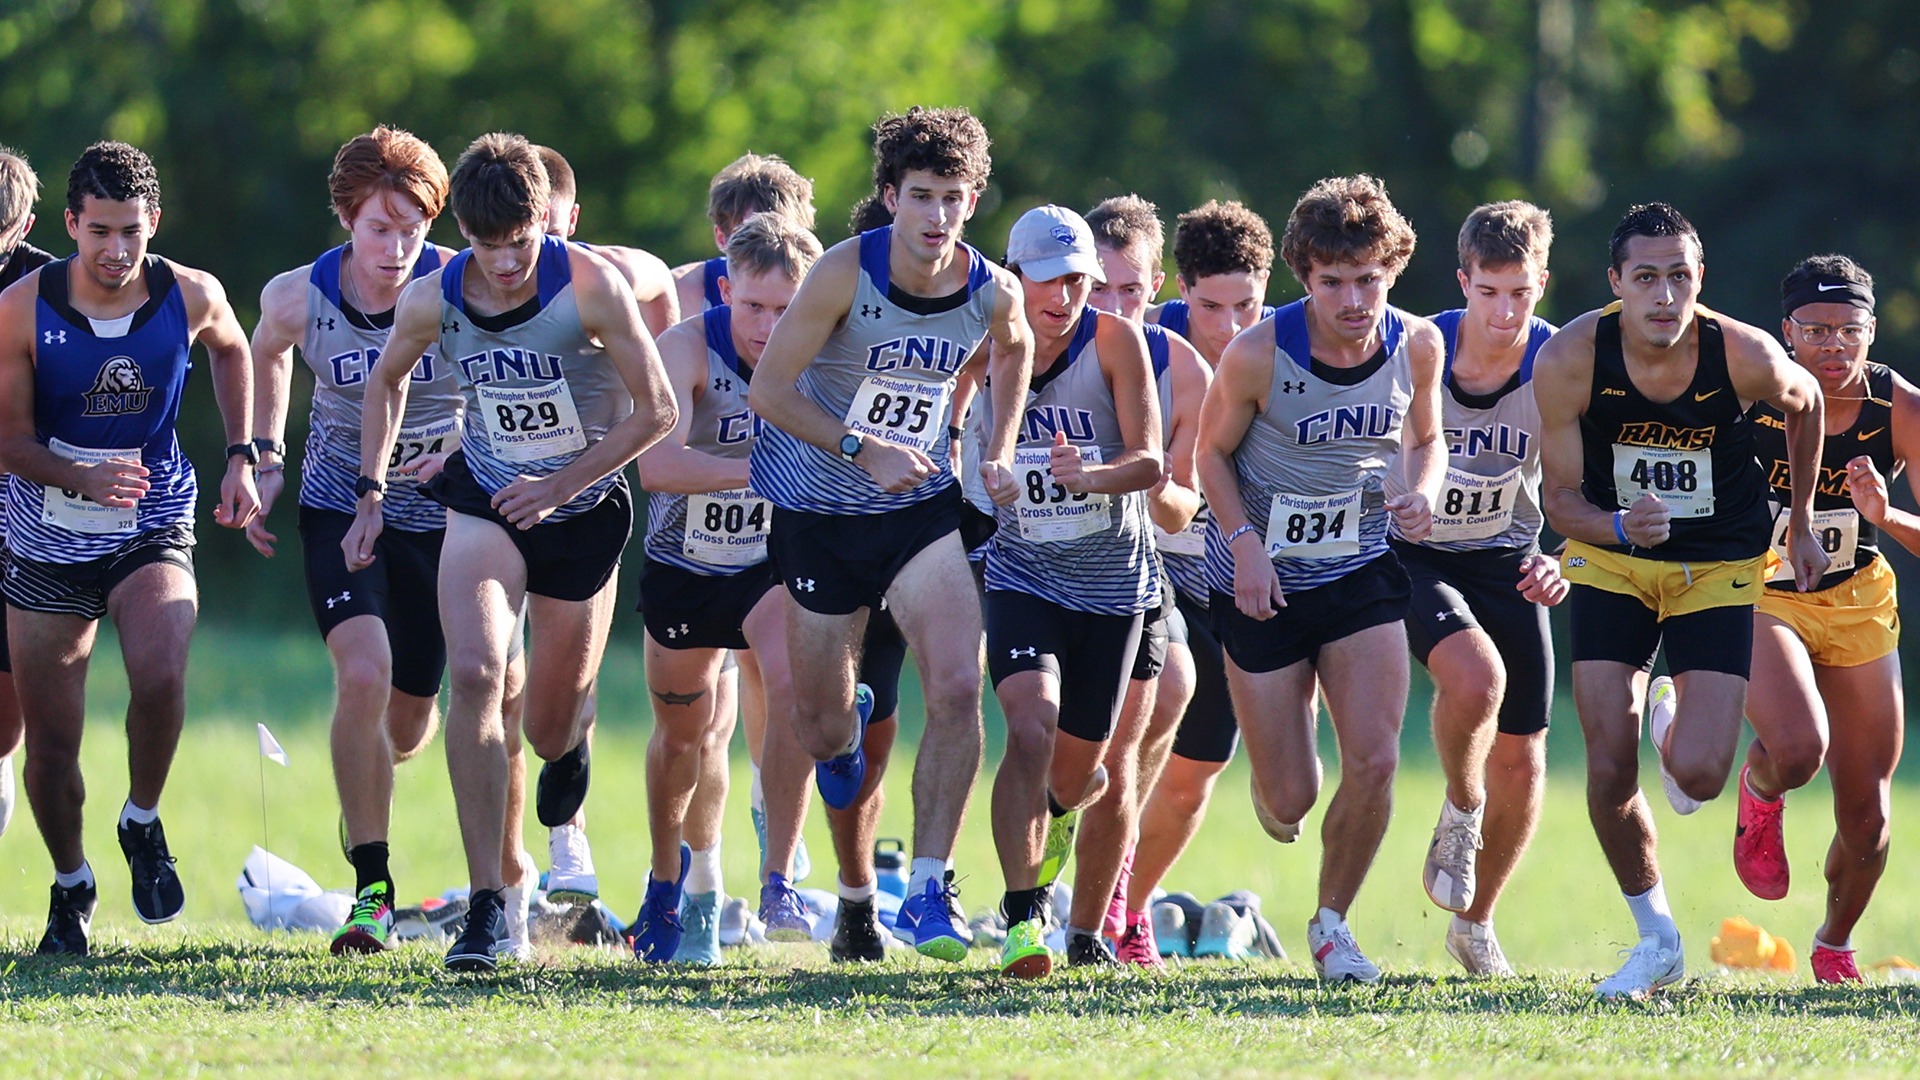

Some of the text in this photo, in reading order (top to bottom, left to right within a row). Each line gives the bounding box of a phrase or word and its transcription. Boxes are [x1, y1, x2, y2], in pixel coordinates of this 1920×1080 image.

[459, 347, 563, 386] CNU
[866, 336, 969, 374] CNU
[481, 384, 562, 402] Christopher Newport
[870, 376, 915, 394] Christopher
[88, 391, 147, 413] EMU
[496, 401, 559, 432] 829
[867, 393, 933, 434] 835
[425, 421, 456, 437] Newport
[493, 425, 574, 443] Cross Country
[850, 420, 931, 451] Cross Country
[1018, 404, 1093, 444] NU
[1295, 402, 1394, 445] CNU
[1617, 421, 1716, 451] RAMS
[1015, 452, 1051, 466] Christoph
[1026, 467, 1089, 504] 83
[1486, 472, 1517, 488] Newport
[1630, 458, 1697, 492] 408
[1021, 502, 1102, 518] Cross Country
[1280, 492, 1358, 511] Christopher Newport
[1444, 487, 1503, 516] 811
[118, 520, 133, 529] 328
[704, 502, 765, 534] 804
[1286, 509, 1346, 544] 834
[1432, 509, 1508, 525] Cross Country
[692, 529, 766, 545] Cross Countr
